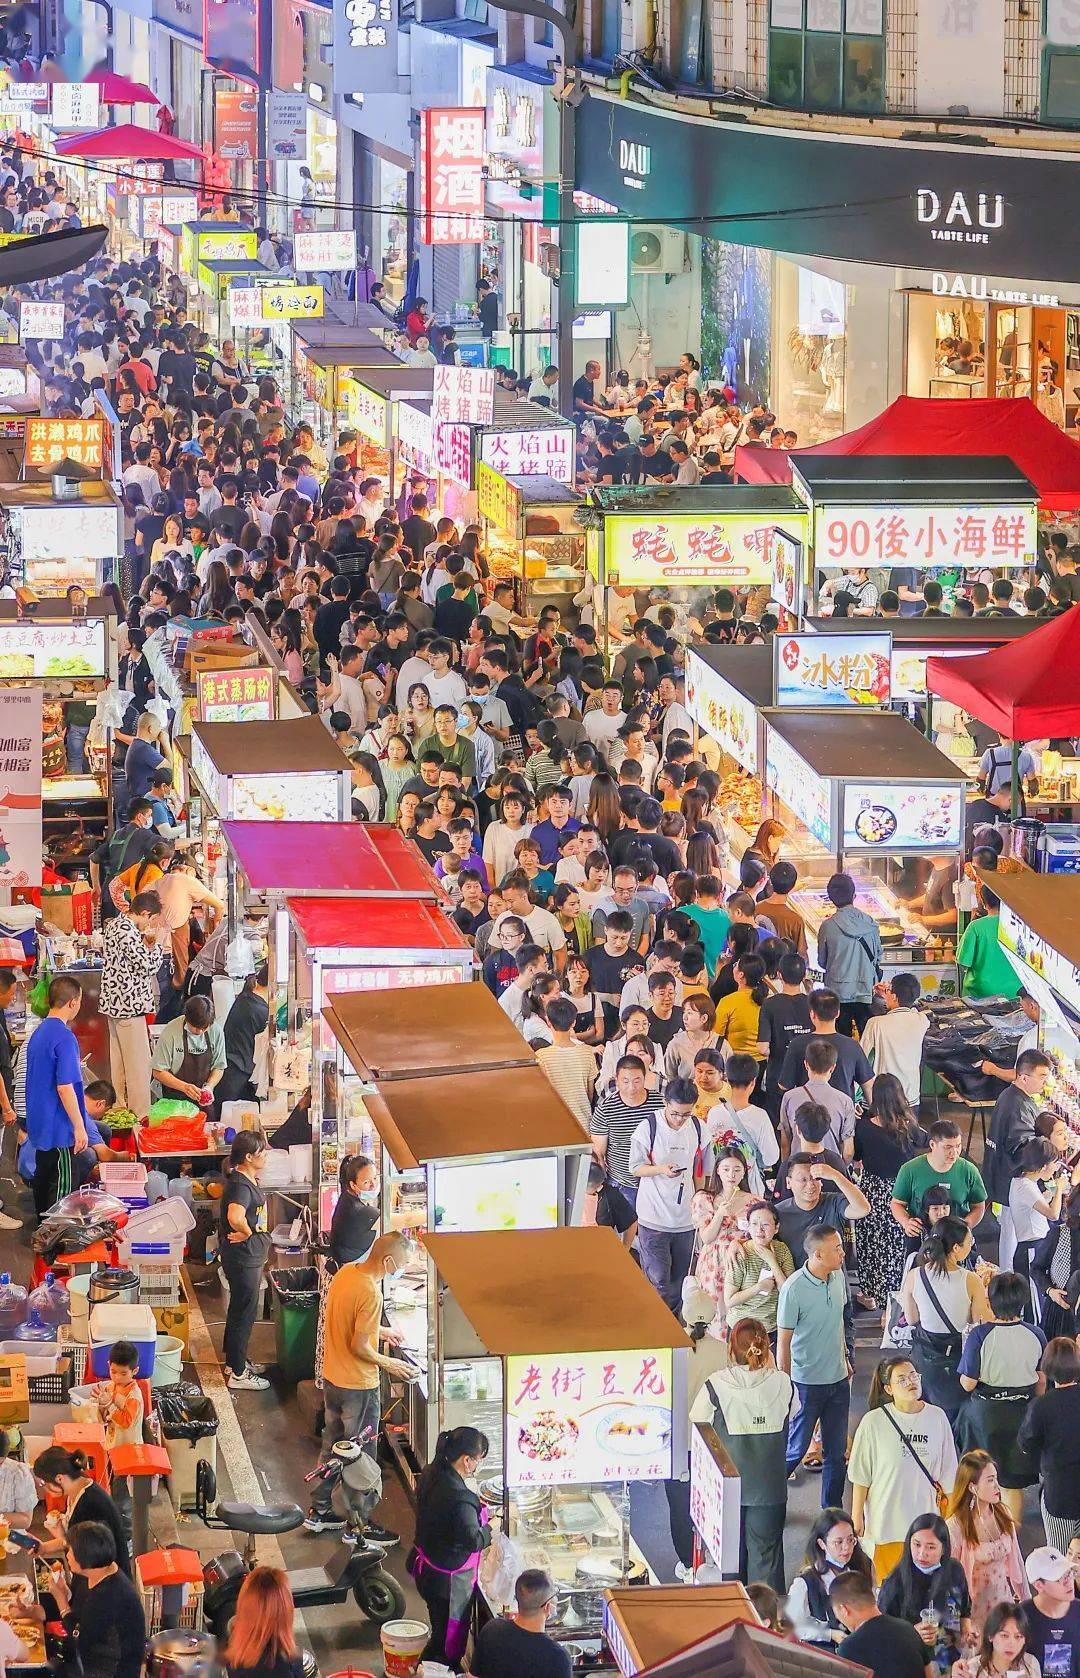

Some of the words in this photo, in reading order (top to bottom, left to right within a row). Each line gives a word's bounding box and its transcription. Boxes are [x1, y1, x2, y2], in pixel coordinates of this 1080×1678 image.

[433, 115, 482, 206] 烟酒
[620, 139, 650, 176] DAU
[917, 188, 1004, 228] DAU
[432, 210, 484, 241] 便利店
[931, 229, 963, 242] TASTE
[965, 233, 989, 244] LIFE
[269, 295, 319, 312] 烤冷面
[932, 273, 989, 299] DAU
[991, 290, 1028, 304] TASTE
[1032, 295, 1059, 306] LIFE
[436, 367, 493, 396] 火焰山
[435, 396, 491, 424] 烤猪蹄
[30, 443, 100, 463] 去骨鸡爪
[490, 434, 566, 456] 火焰山
[827, 514, 1026, 559] 90後小海鲜
[802, 653, 877, 690] 冰粉
[203, 676, 270, 704] 港式蒸肠粉
[514, 1356, 665, 1406] 老街豆花
